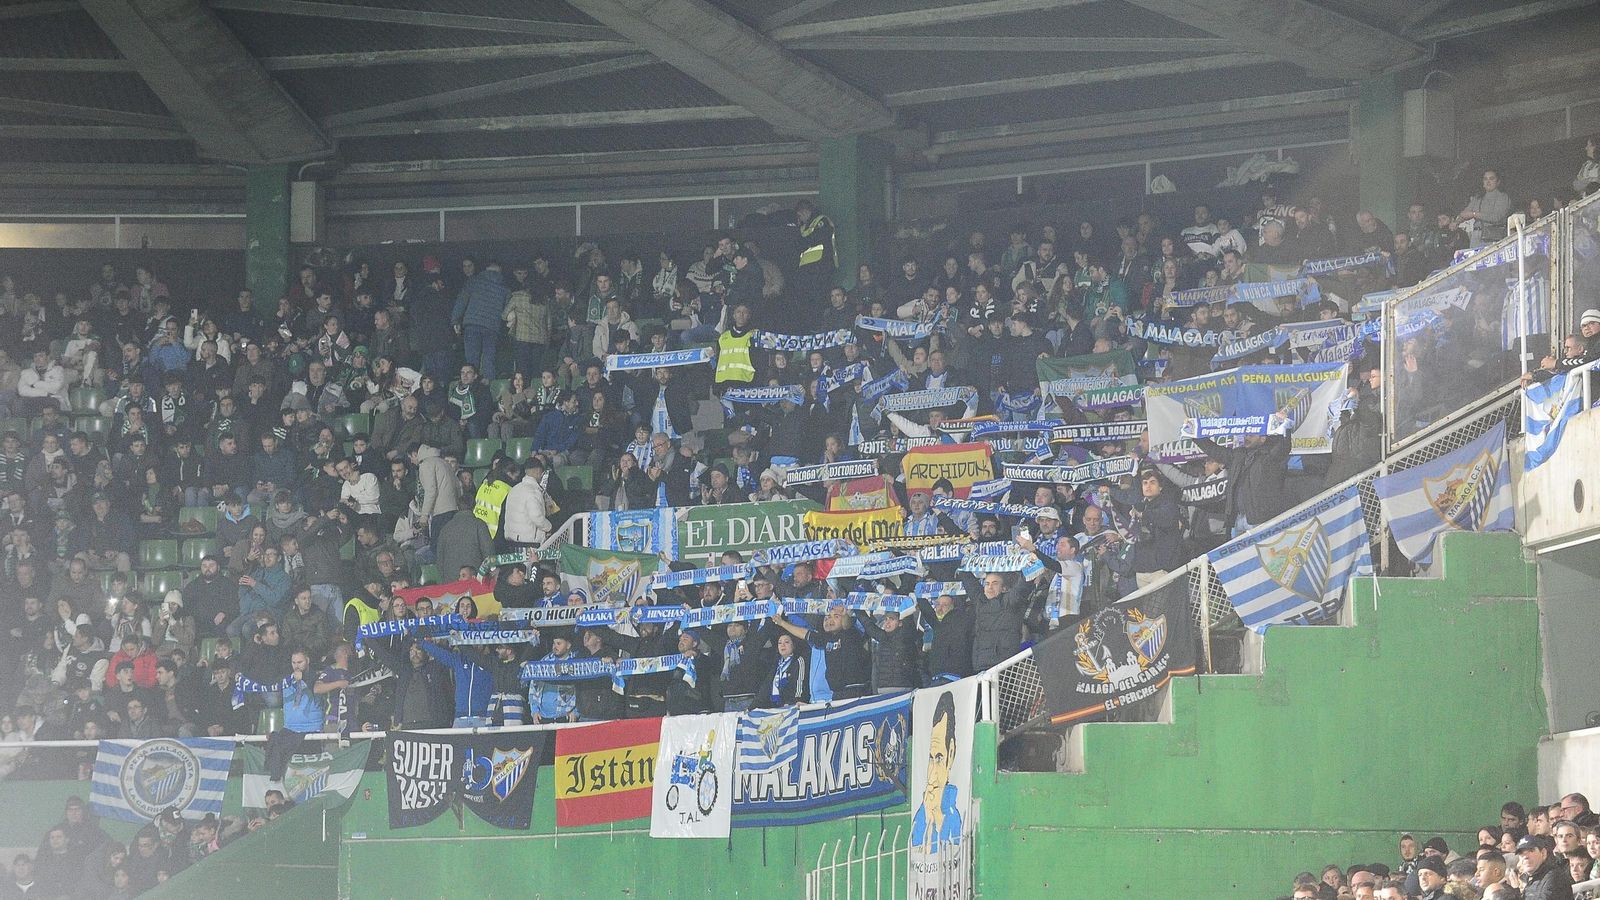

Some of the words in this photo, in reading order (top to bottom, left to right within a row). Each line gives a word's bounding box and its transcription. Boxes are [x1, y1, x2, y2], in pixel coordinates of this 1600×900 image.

[1310, 251, 1377, 273] MALAGA
[1242, 286, 1271, 300] NUNCA
[886, 321, 934, 337] MALAG
[780, 335, 834, 349] MALAGA
[1242, 373, 1271, 385] PEÑA
[1079, 427, 1091, 437] DE
[1093, 425, 1105, 437] LA
[1201, 427, 1229, 436] Orgullo
[1231, 426, 1245, 434] del
[1246, 425, 1262, 433] Sur
[1447, 481, 1475, 518] MALAGA
[1260, 494, 1352, 538] MALAGUISTA
[684, 520, 723, 548] EL
[727, 512, 807, 547] DIARI
[770, 543, 831, 560] MALAGA
[463, 629, 519, 641] MALAGA
[523, 664, 557, 678] ALAKA
[1118, 676, 1139, 692] DEL
[1104, 702, 1115, 713] EL
[1119, 684, 1158, 706] PERCHEL
[392, 739, 454, 781] SUPER
